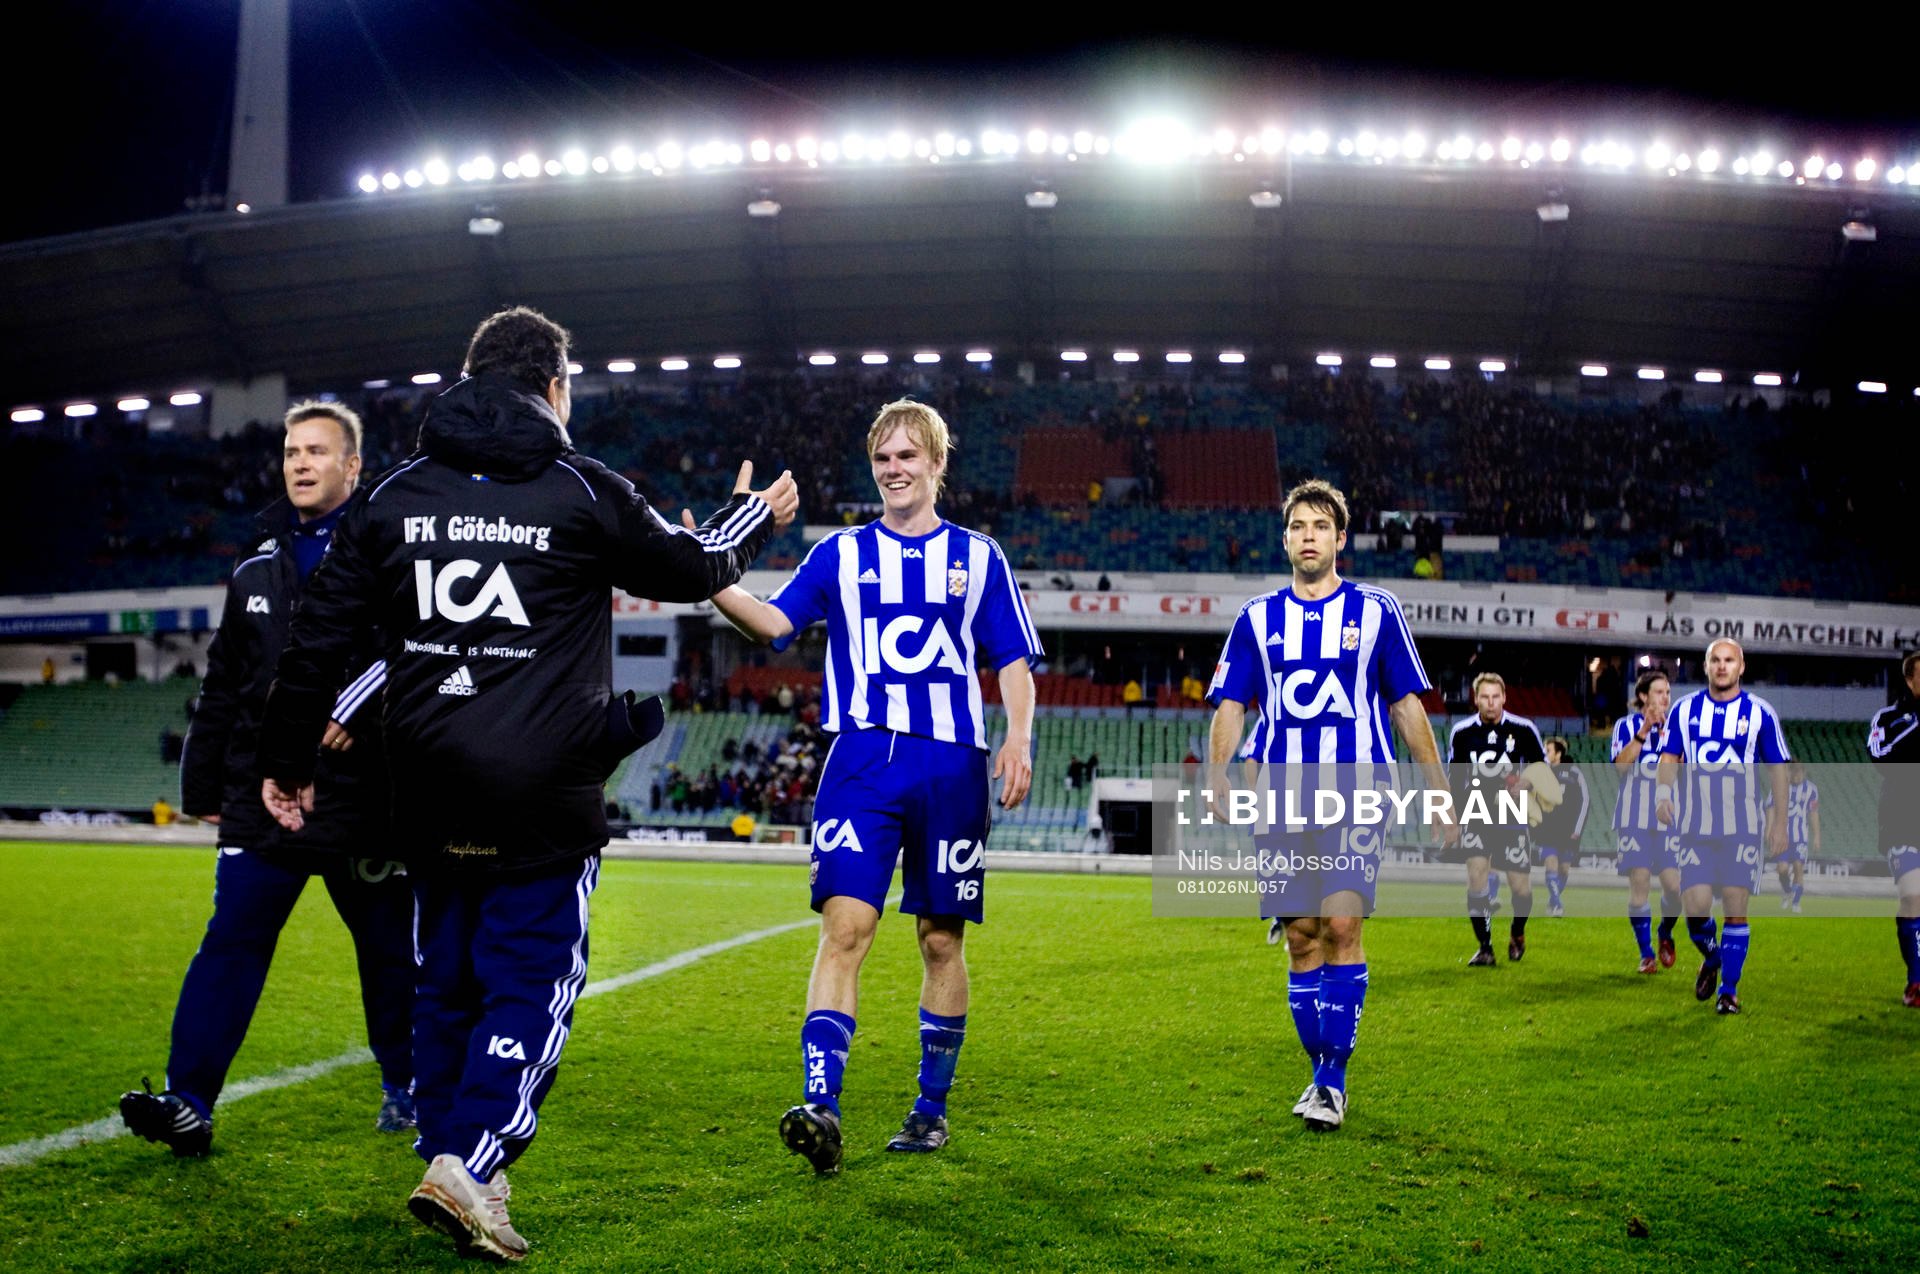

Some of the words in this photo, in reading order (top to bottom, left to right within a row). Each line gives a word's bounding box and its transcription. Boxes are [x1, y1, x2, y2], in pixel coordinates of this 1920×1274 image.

[404, 516, 436, 544] IFK
[447, 516, 551, 551] Göteborg
[903, 547, 923, 559] ICA
[246, 595, 270, 614] ICA
[415, 559, 531, 627] ICA
[1069, 594, 1129, 613] GT
[1160, 597, 1220, 614] GT
[1304, 611, 1321, 622] ICA
[1402, 603, 1468, 622] CHEN
[1478, 608, 1484, 624] I
[1494, 609, 1534, 627] GT!
[1555, 609, 1619, 630] GT
[1646, 612, 1695, 637] LÄS
[1704, 619, 1744, 639] OM
[1753, 620, 1883, 648] MATCHEN
[468, 647, 478, 656] IS
[483, 647, 537, 659] NOTHING
[864, 615, 968, 676] ICA
[1273, 669, 1356, 720] ICA
[1470, 750, 1513, 779] ICA
[1633, 753, 1661, 779] IC
[1691, 741, 1745, 774] ICA
[811, 818, 863, 852] ICA
[1340, 826, 1381, 860] ICA
[1619, 836, 1640, 852] CA
[937, 839, 986, 874] ICA
[1257, 848, 1296, 878] CA
[1678, 848, 1701, 867] CA
[1364, 864, 1375, 883] 9
[954, 880, 979, 901] 16
[487, 1035, 526, 1060] ICA
[807, 1042, 828, 1095] SKF
